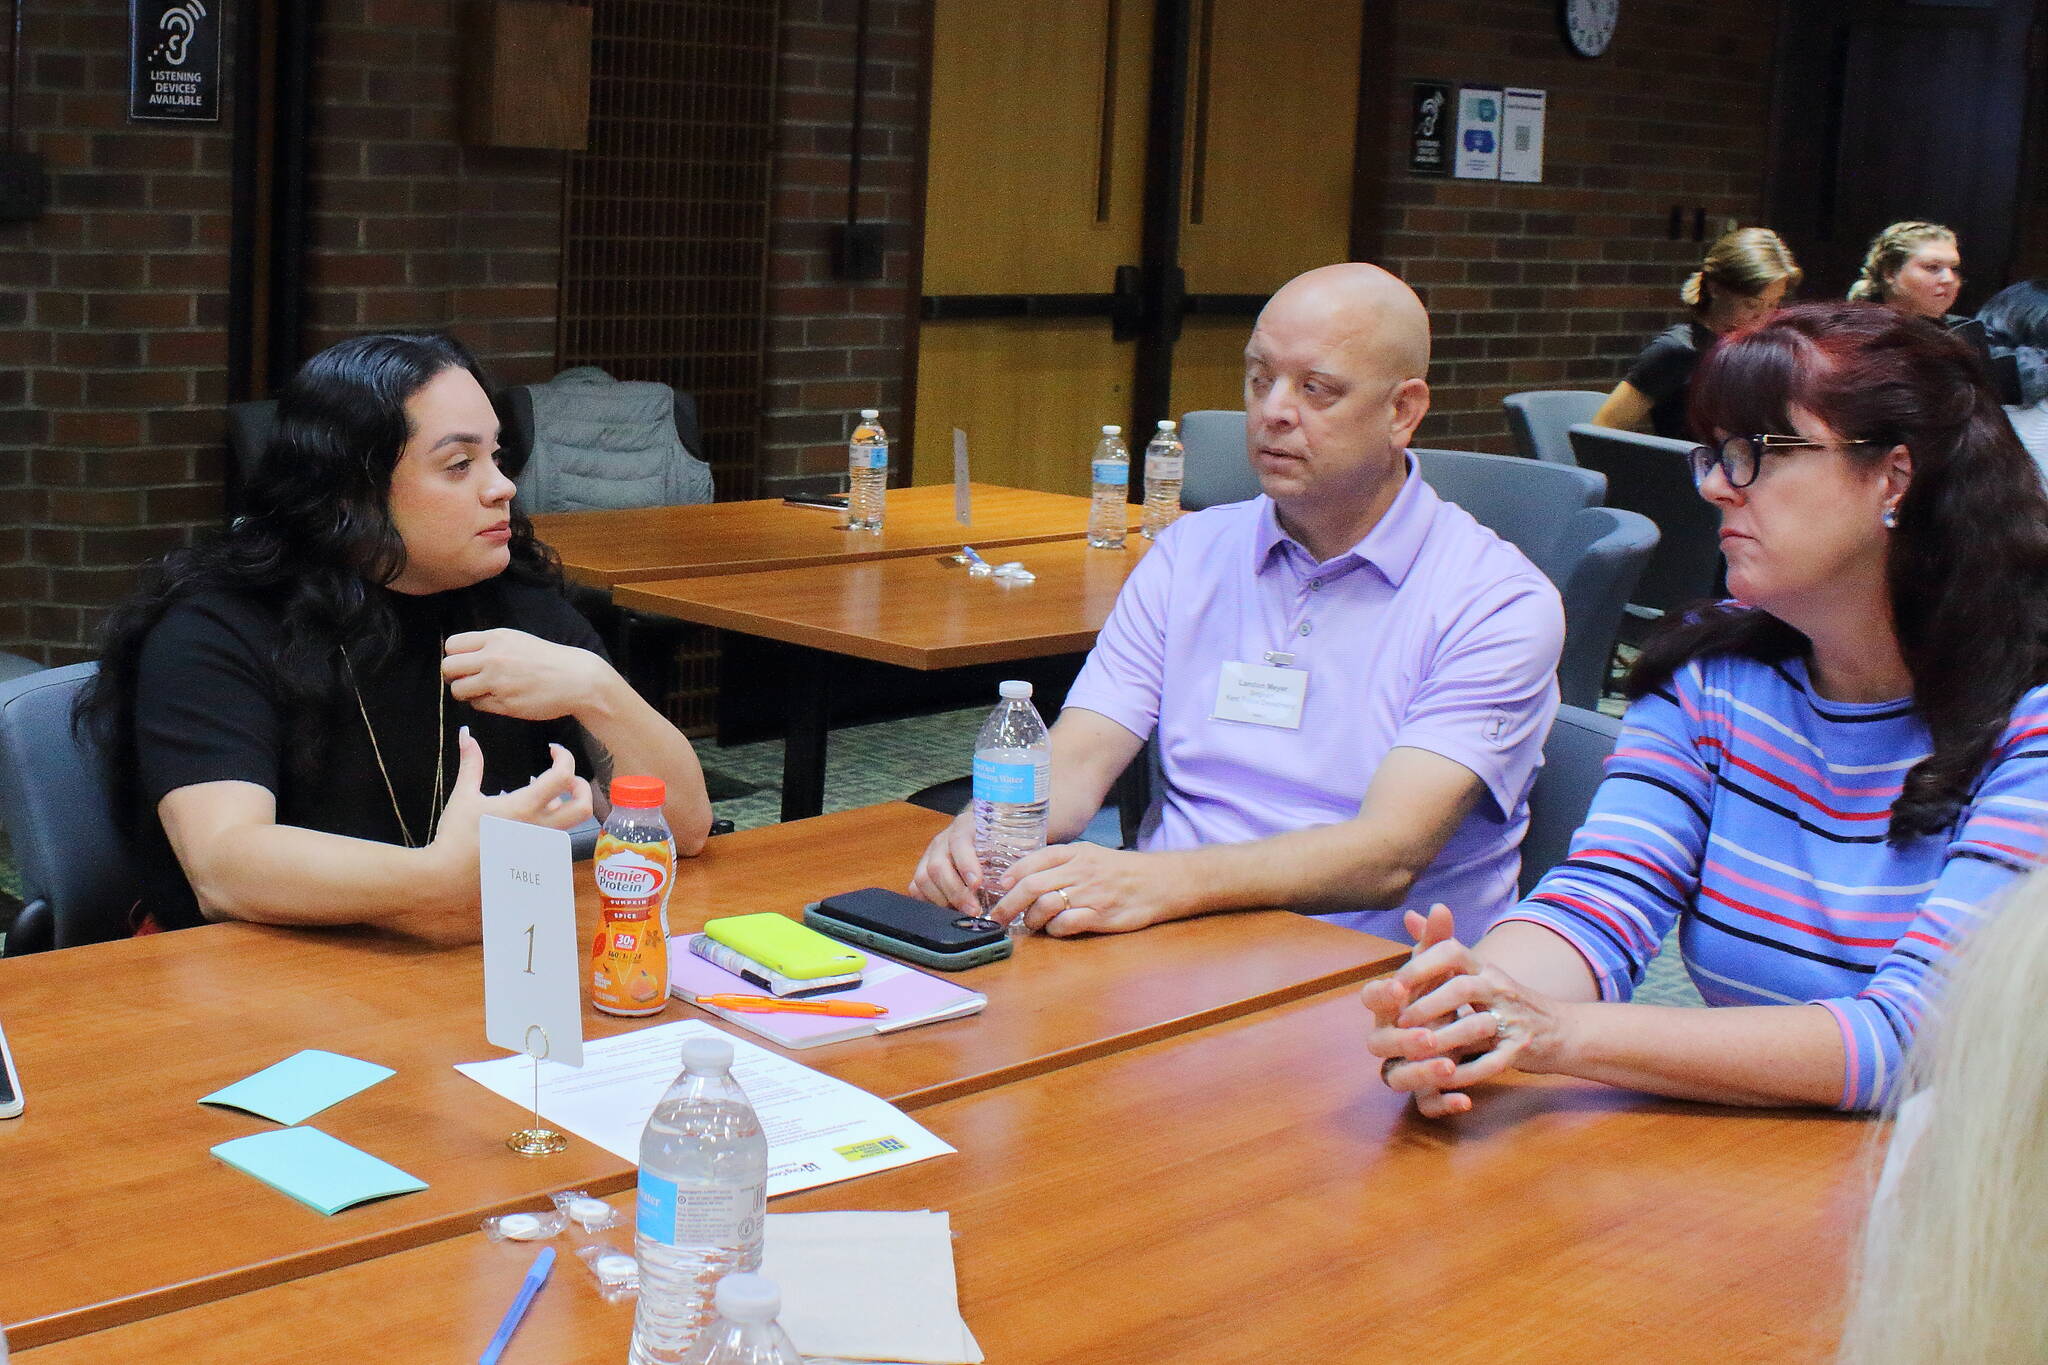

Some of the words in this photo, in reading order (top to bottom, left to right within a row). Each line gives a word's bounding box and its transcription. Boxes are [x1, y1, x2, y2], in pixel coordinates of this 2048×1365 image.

[151, 70, 201, 82] LISTENING
[156, 83, 197, 94] DEVICES
[149, 95, 202, 106] AVAILABLE
[510, 868, 541, 886] TABLE
[598, 865, 648, 882] Premier
[600, 876, 642, 892] Protein
[523, 923, 535, 975] 1
